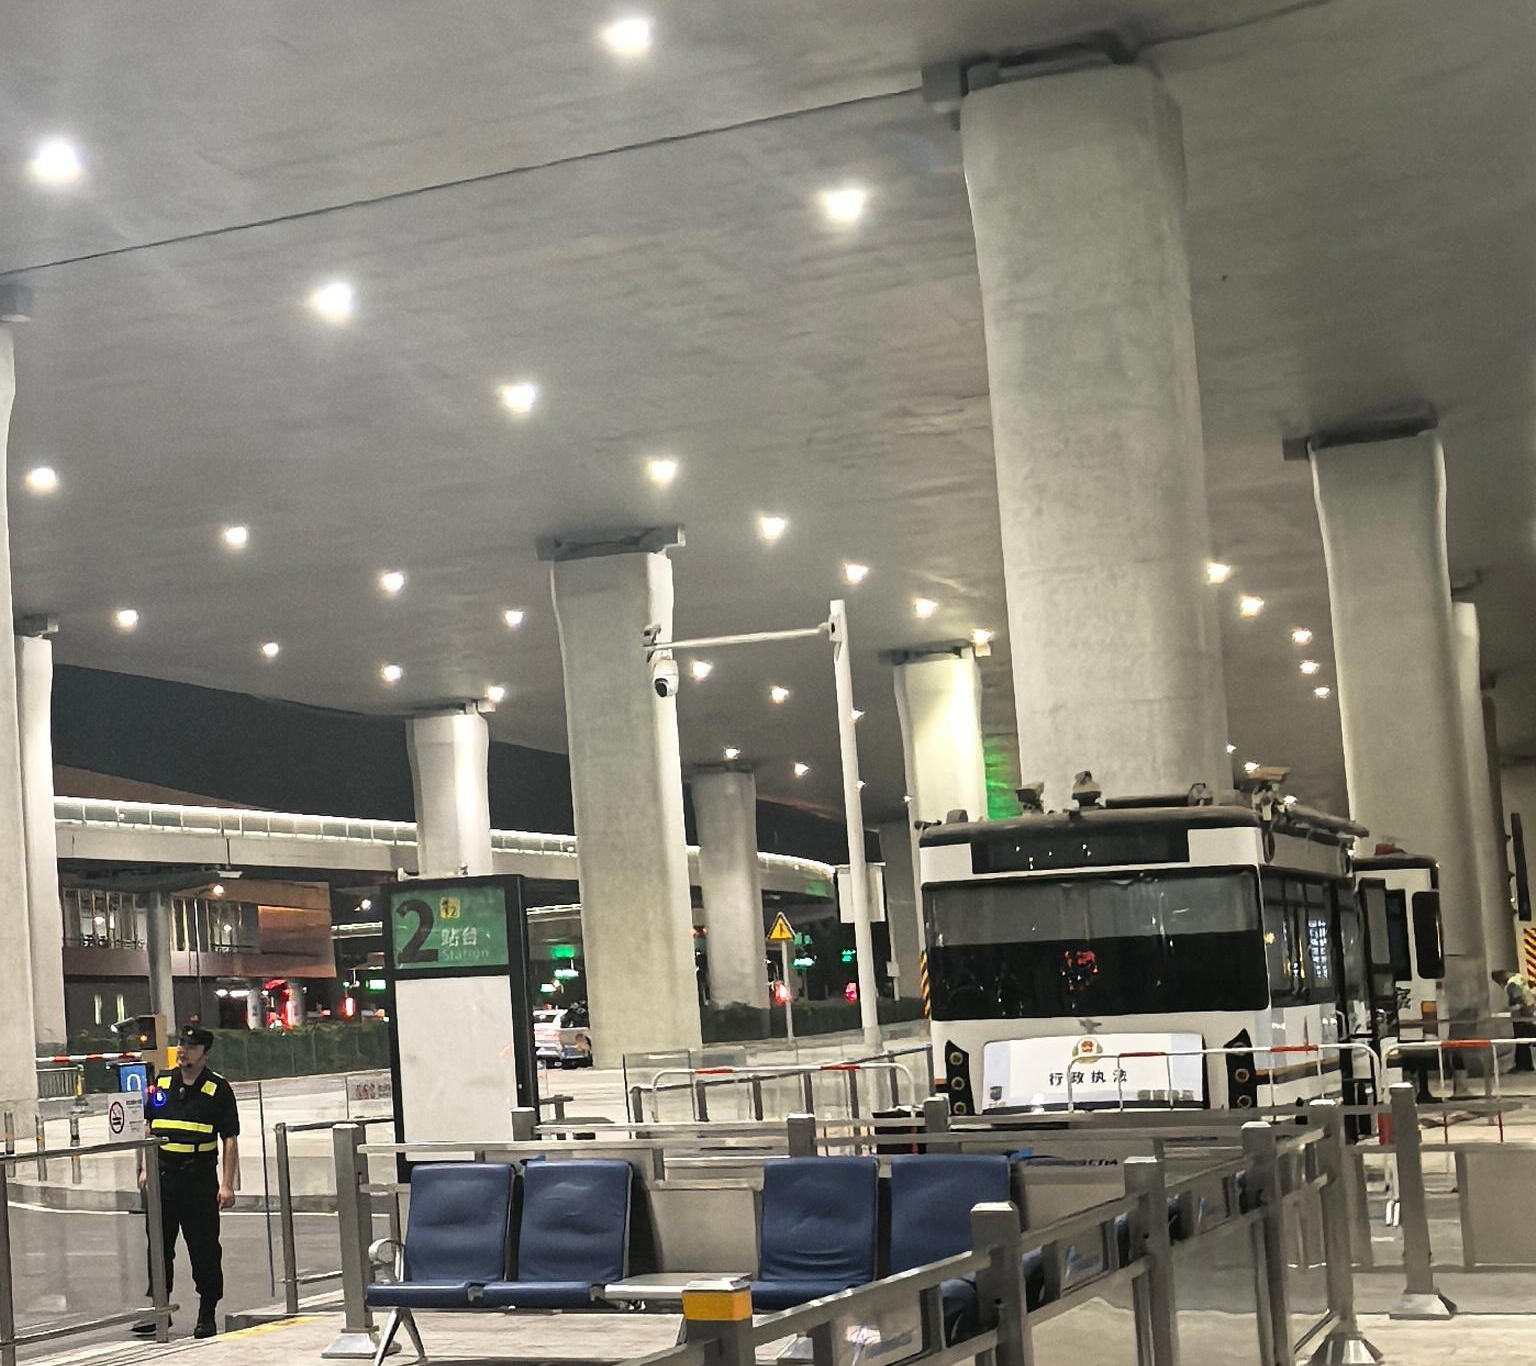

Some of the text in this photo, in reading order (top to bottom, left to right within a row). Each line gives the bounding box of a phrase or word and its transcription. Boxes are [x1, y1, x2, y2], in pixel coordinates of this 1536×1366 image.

[396, 899, 438, 963] 2
[441, 926, 477, 947] 站台
[1049, 1069, 1128, 1086] 行政执法
